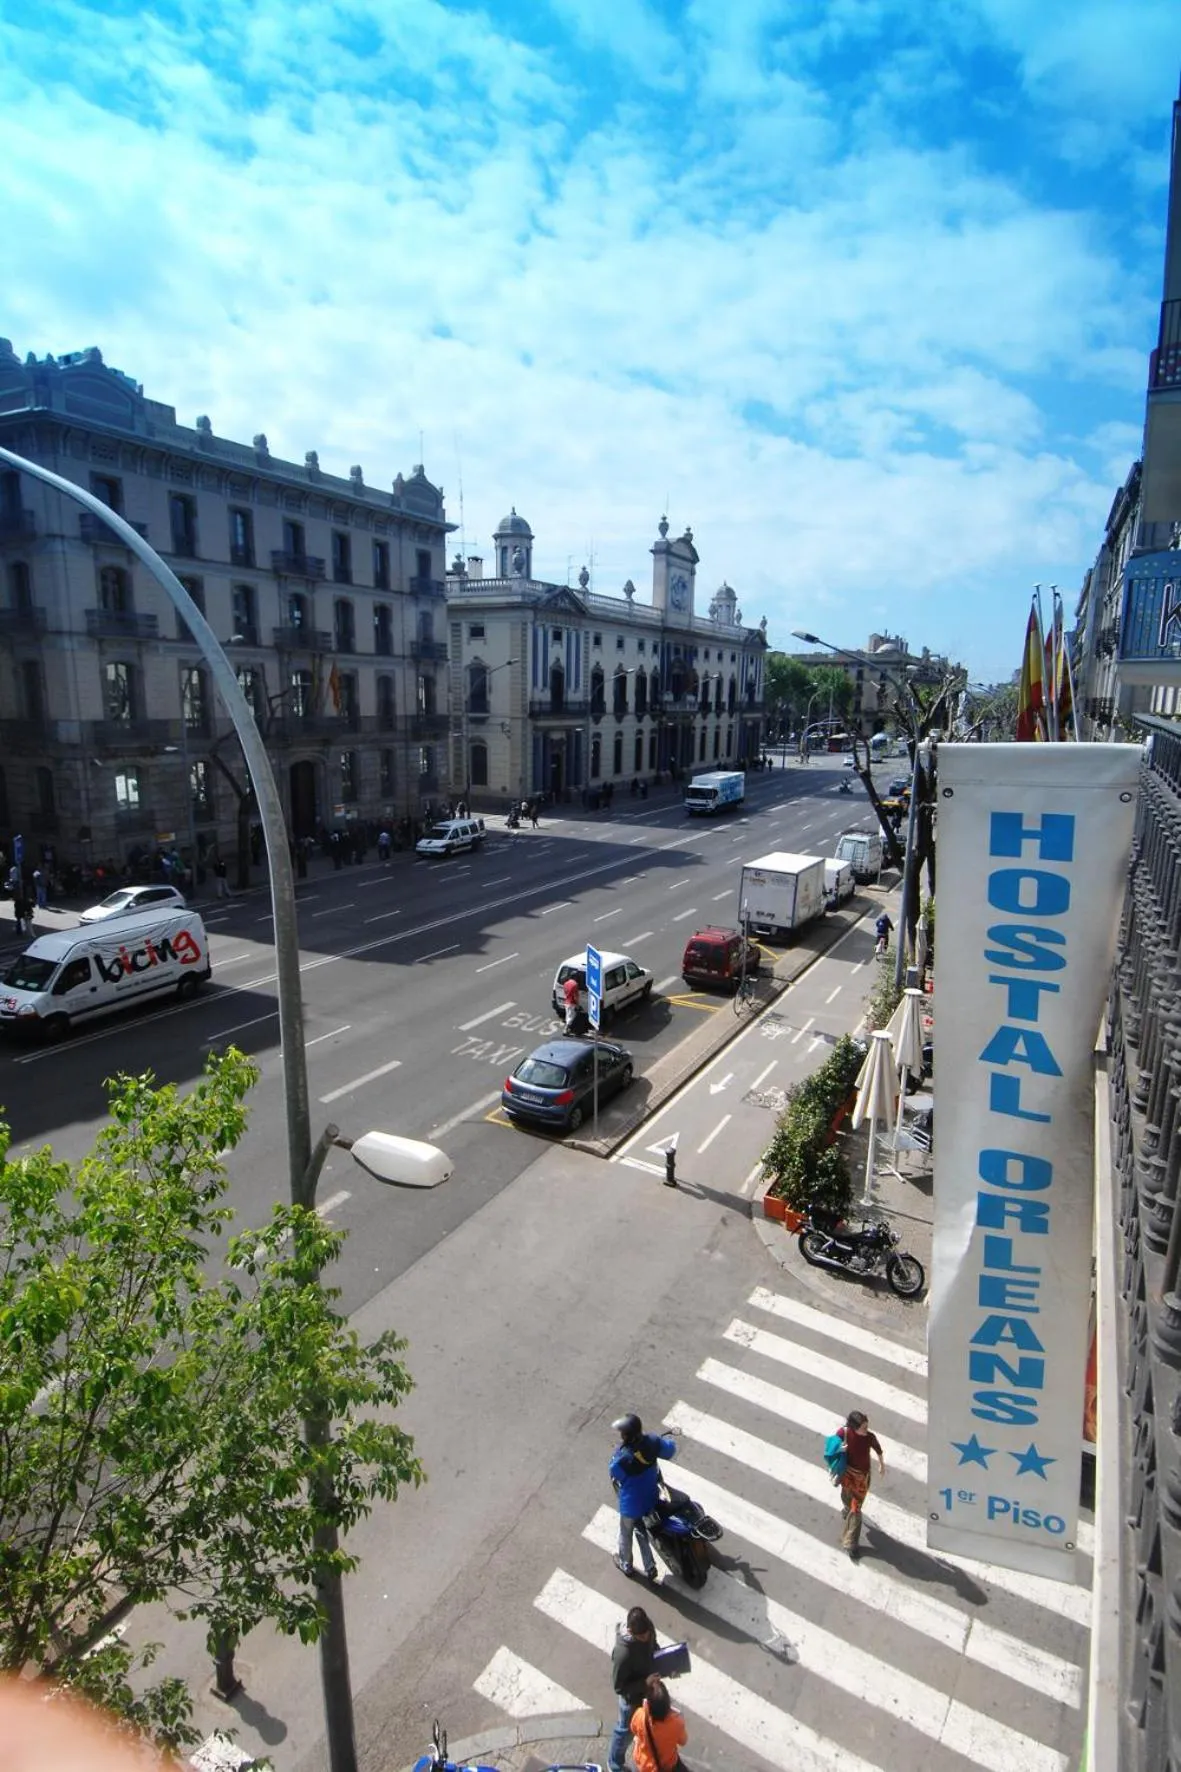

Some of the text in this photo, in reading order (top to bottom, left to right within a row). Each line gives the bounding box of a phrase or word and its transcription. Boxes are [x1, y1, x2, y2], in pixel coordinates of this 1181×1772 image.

[93, 929, 201, 983] bicing
[502, 1012, 565, 1036] BUS
[450, 1036, 525, 1065] TAXI
[969, 811, 1076, 1426] HOSTAL ORLEANS
[986, 1495, 1066, 1535] Piso
